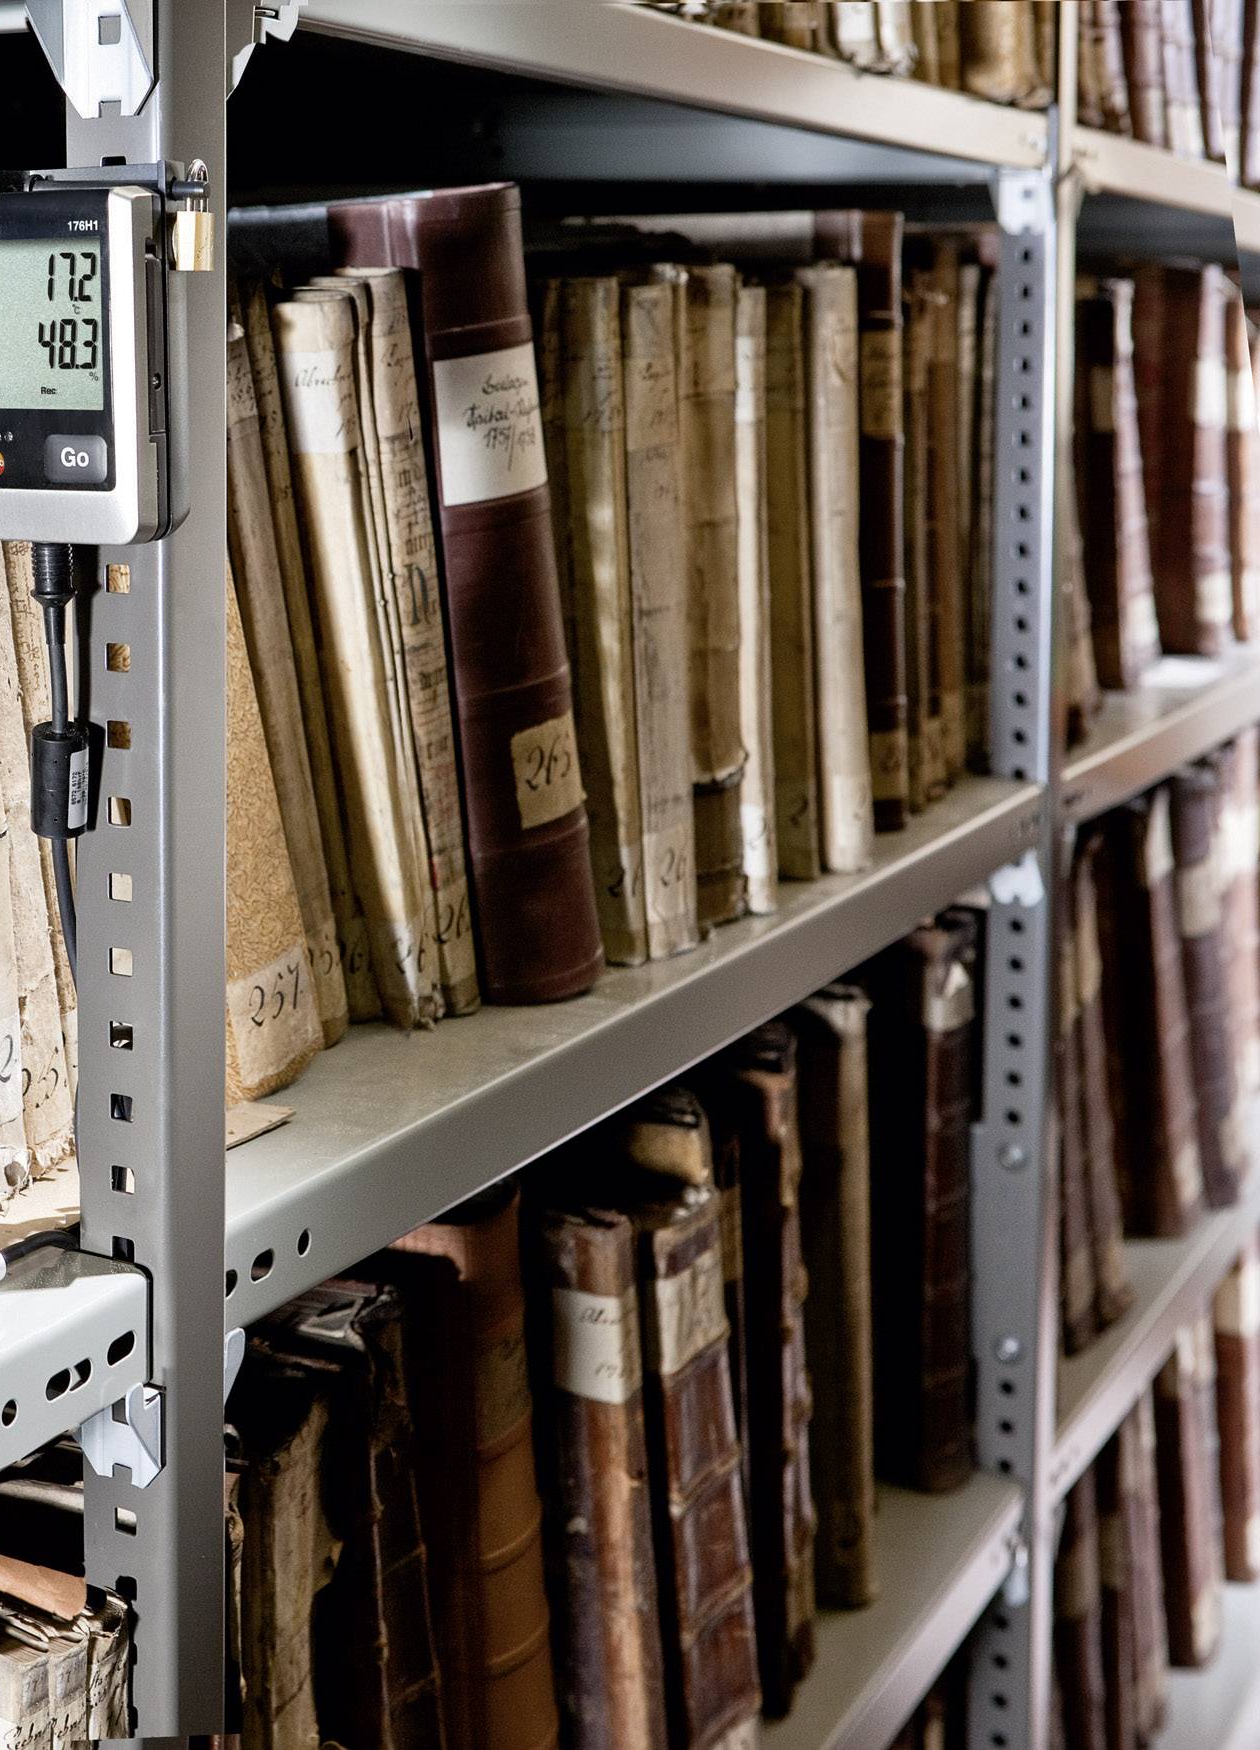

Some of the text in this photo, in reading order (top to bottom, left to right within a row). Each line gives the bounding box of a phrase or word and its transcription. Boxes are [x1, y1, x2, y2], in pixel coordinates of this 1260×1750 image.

[67, 220, 99, 231] 176H1
[47, 252, 97, 302] 17.2
[38, 318, 98, 369] 48.3
[40, 386, 57, 396] Rec
[60, 446, 90, 467] Go
